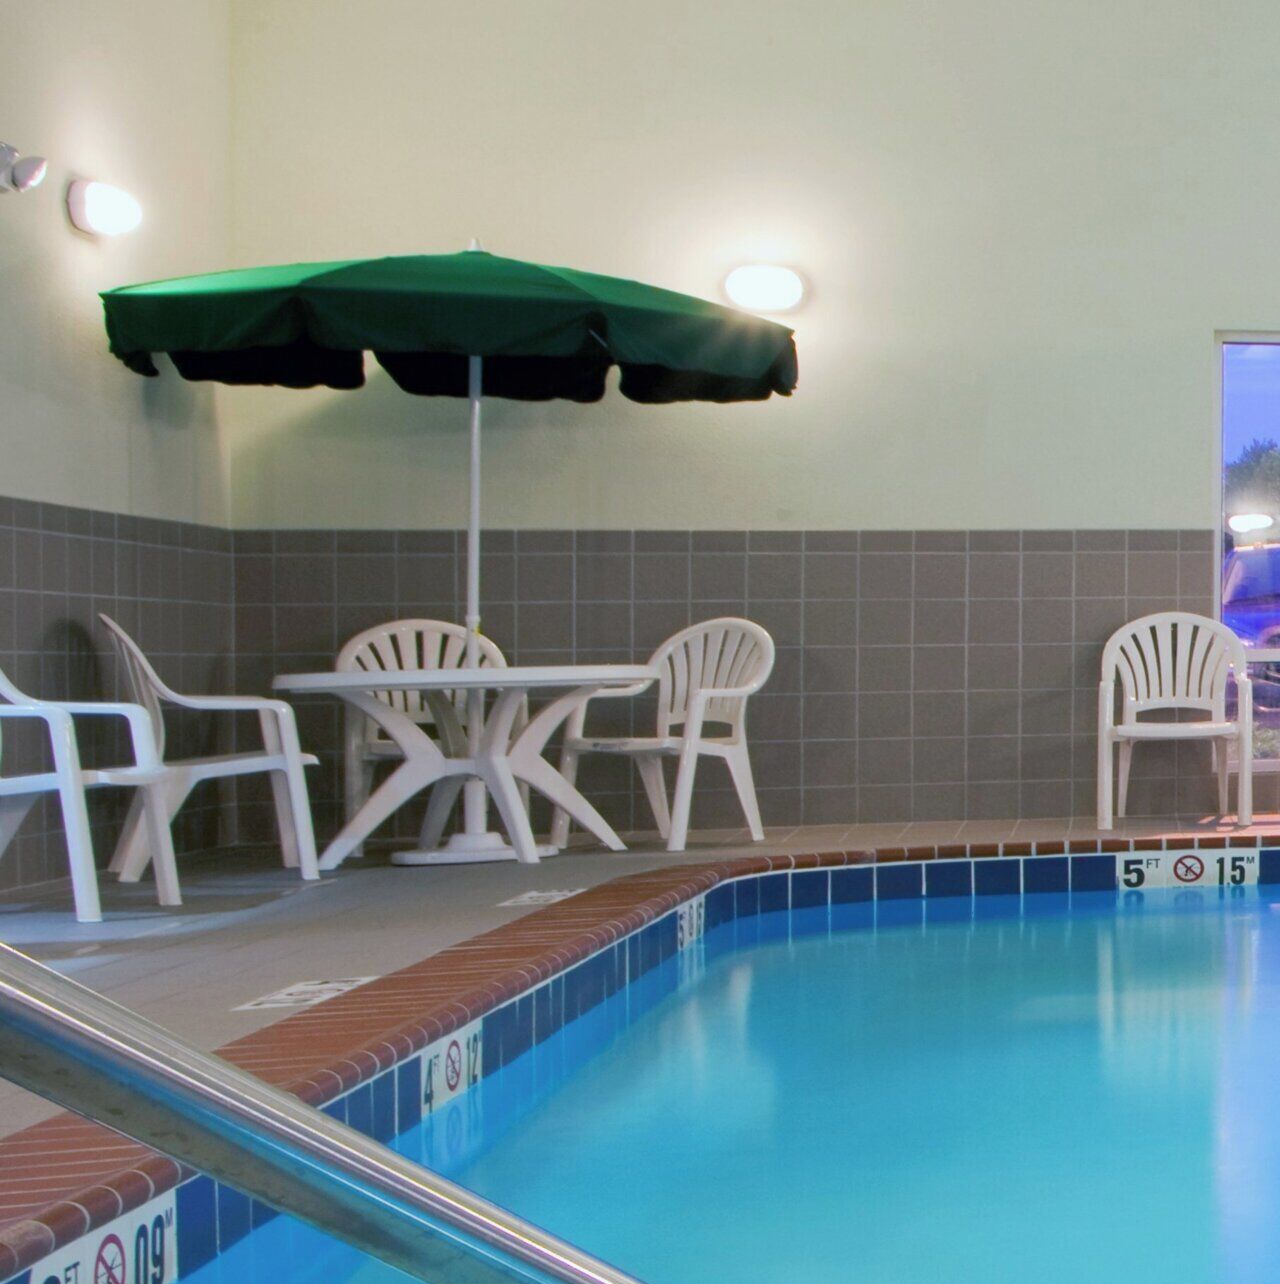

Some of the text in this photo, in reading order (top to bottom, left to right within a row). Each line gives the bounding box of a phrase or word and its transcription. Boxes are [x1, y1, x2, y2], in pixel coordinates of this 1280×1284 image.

[1124, 859, 1160, 888] 5 FT
[424, 1059, 433, 1113] 4
